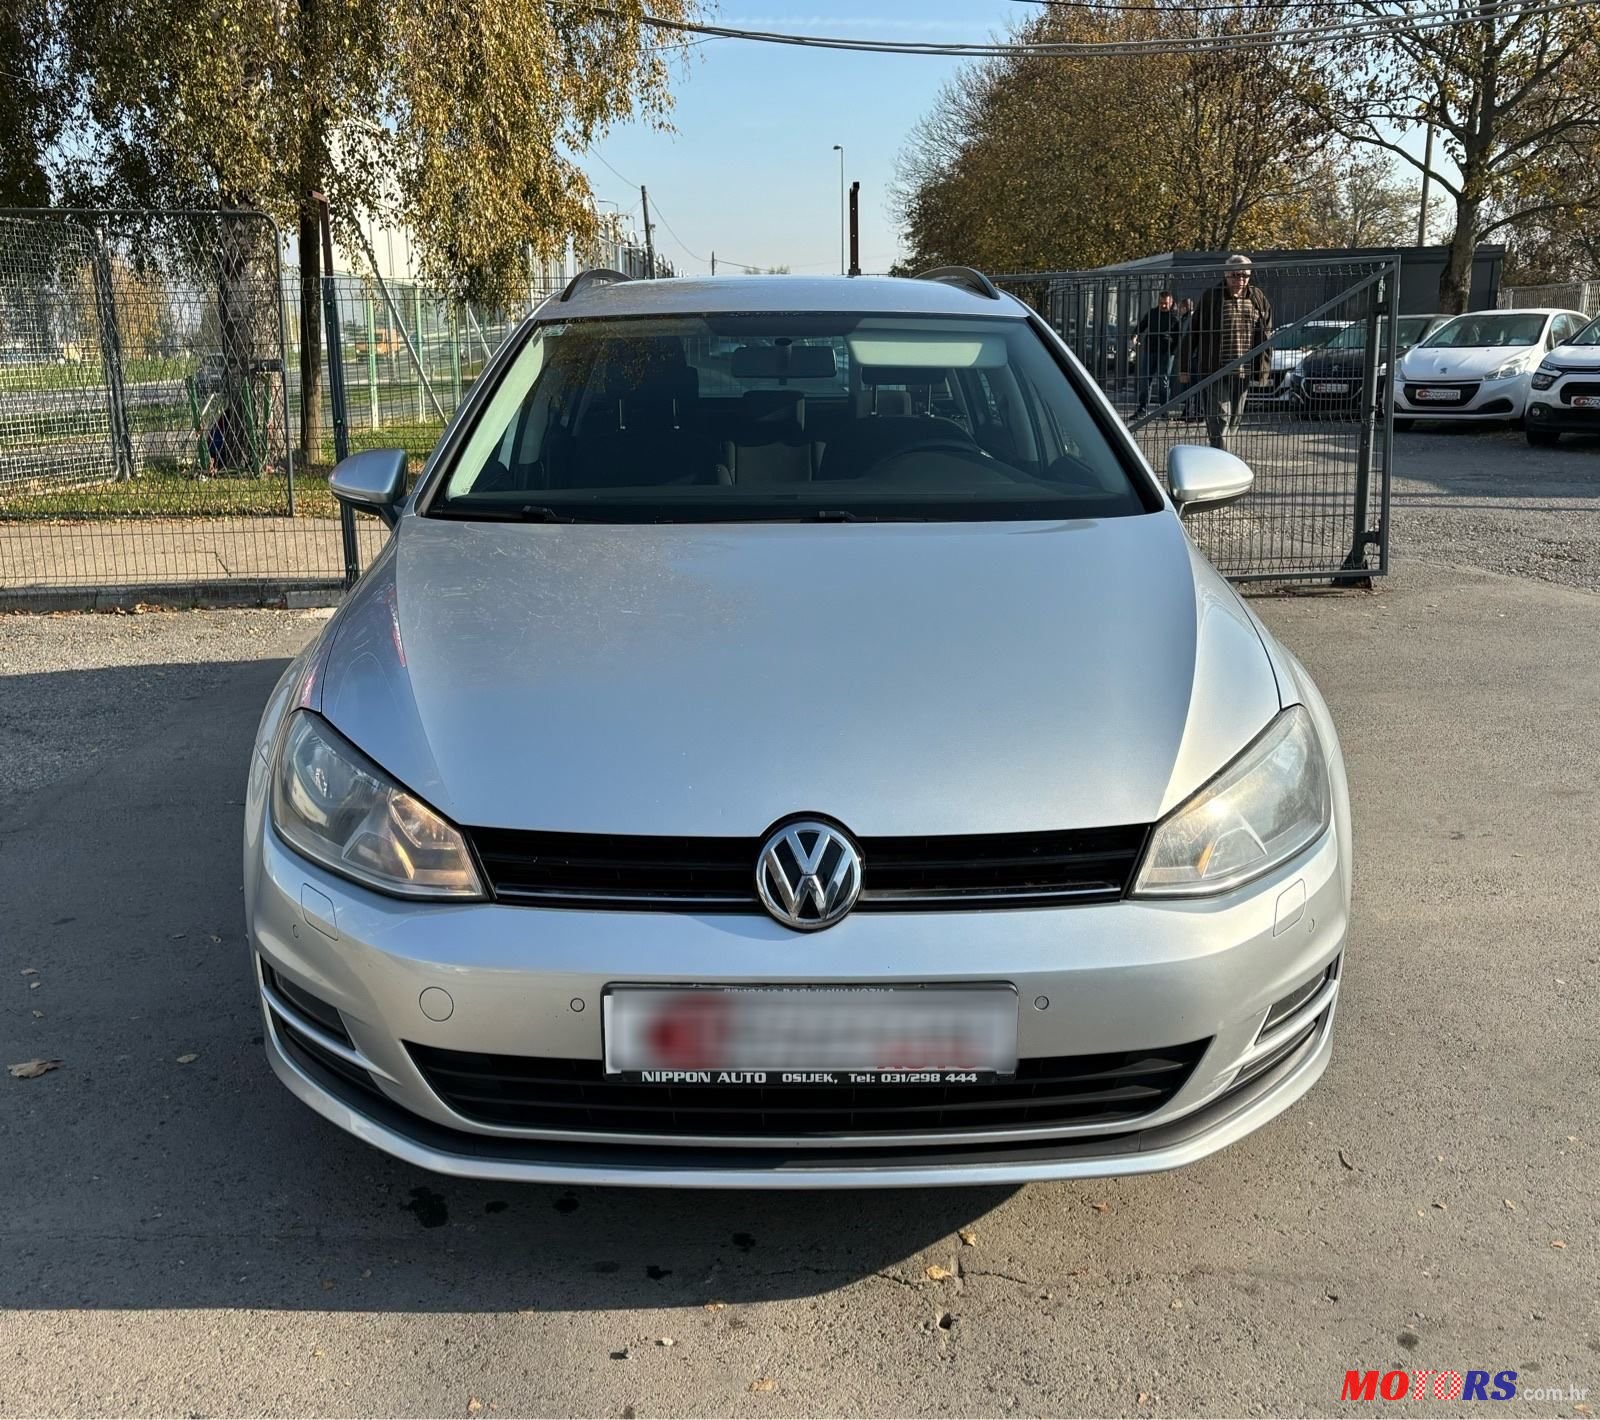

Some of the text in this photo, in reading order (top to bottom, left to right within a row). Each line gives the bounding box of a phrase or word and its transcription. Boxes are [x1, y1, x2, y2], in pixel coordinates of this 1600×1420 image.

[641, 1071, 978, 1084] NIPPON AUTO OSIJEK, Tel: 031/298 444
